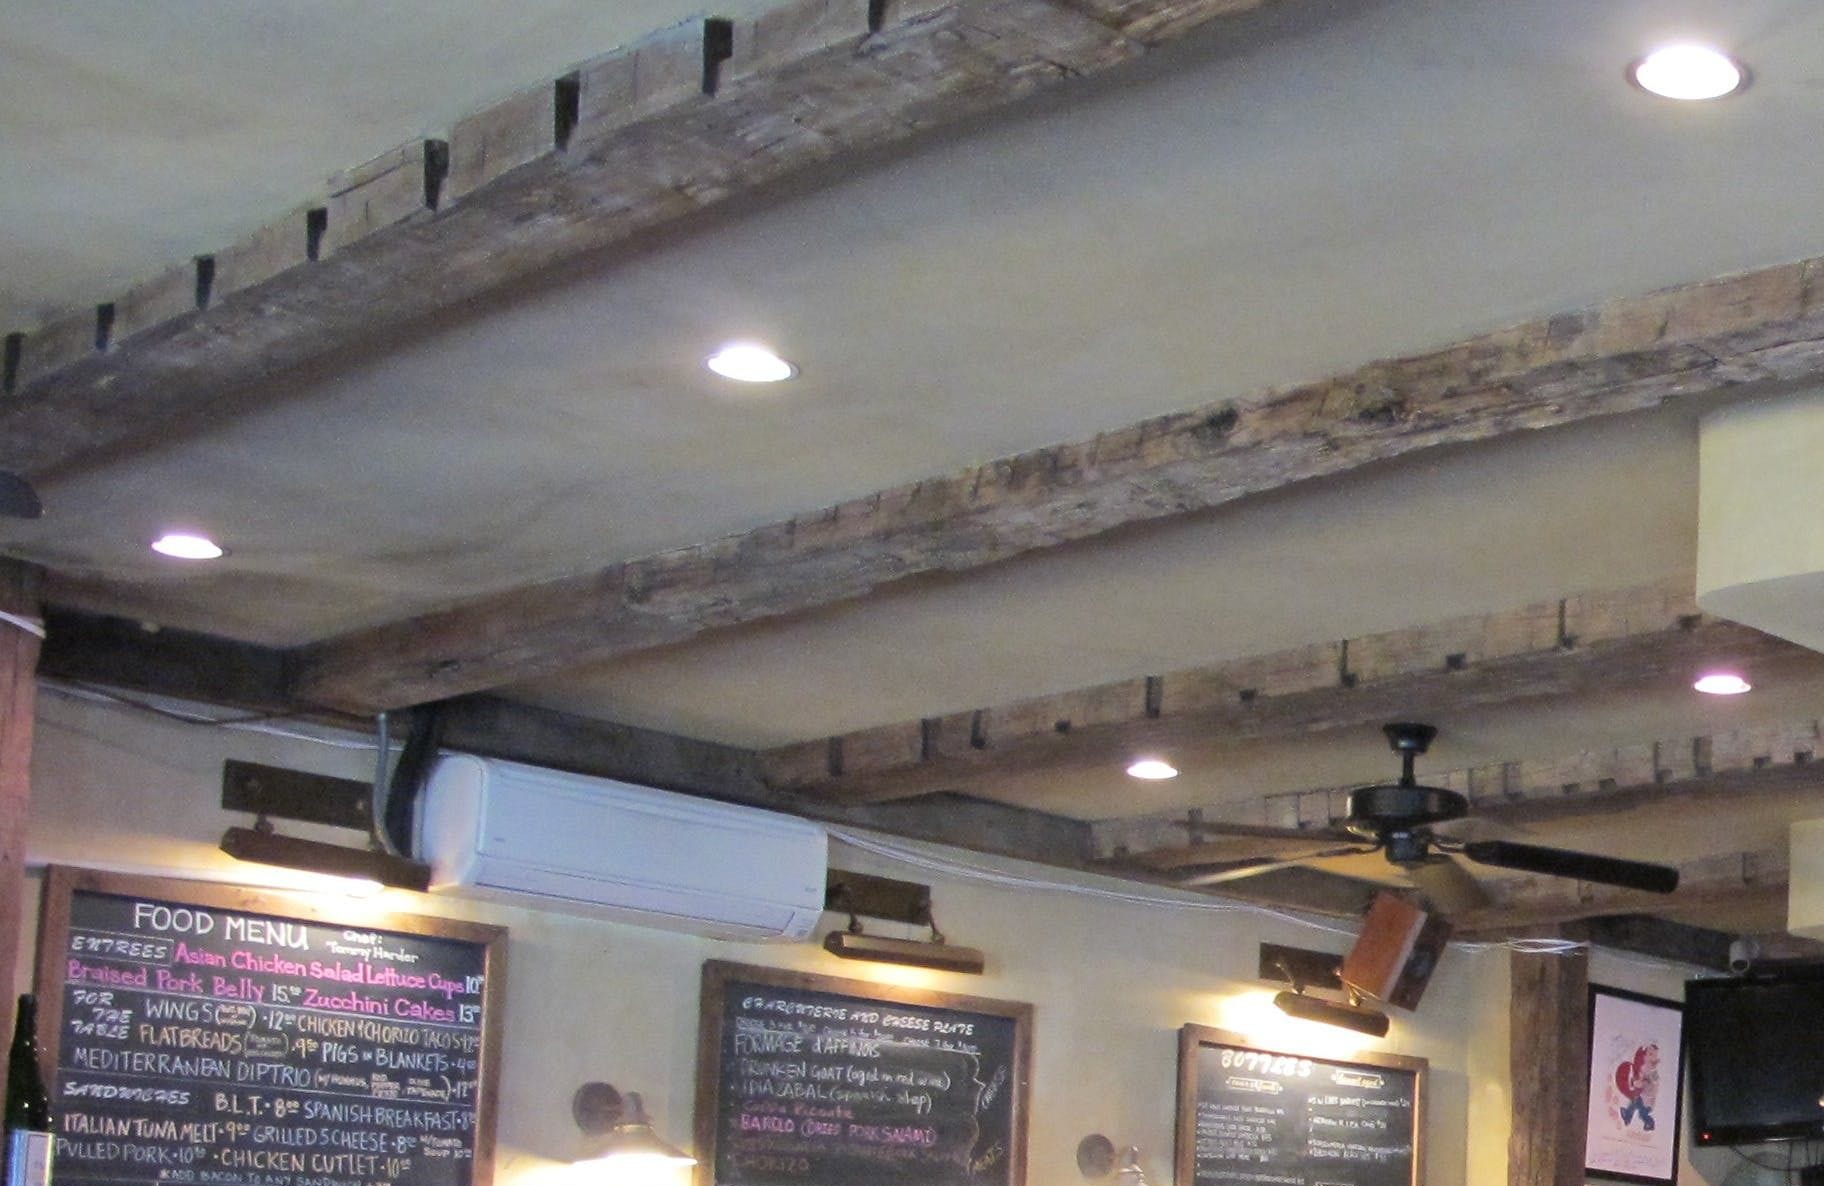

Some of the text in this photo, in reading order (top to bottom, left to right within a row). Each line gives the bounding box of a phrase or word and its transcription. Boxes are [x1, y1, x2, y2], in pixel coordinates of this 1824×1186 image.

[134, 903, 308, 950] FOOD MENU
[71, 936, 167, 960] ENTREES
[175, 942, 464, 998] Asian Chicken Salad Lettuce Cups
[67, 959, 455, 1022] Braised Pork Belly Zucchini Cakes
[73, 990, 114, 1006] FOR
[71, 1020, 131, 1040] TABLE
[92, 1007, 133, 1024] THE
[145, 999, 213, 1022] WINGS
[297, 1015, 354, 1037] CHICKEN
[882, 1012, 931, 1031] CHEESE
[934, 1021, 976, 1036] PLATE
[140, 1024, 241, 1054] FLATBREADS
[322, 1041, 358, 1063] PIGS
[375, 1048, 448, 1072] BLANKETS
[64, 1082, 190, 1104] SANDWICHES
[304, 1102, 372, 1123] SPANISH
[375, 1107, 456, 1131] BREAKFAST
[64, 1113, 130, 1136] ITALIAN
[132, 1118, 177, 1140] TUNA
[179, 1121, 218, 1144] MELT
[252, 1125, 317, 1147] GRILLED
[332, 1128, 387, 1152] CHEESE
[124, 1144, 174, 1164] PORK
[221, 1148, 304, 1172] CHICKEN
[312, 1153, 380, 1175] CUTLET
